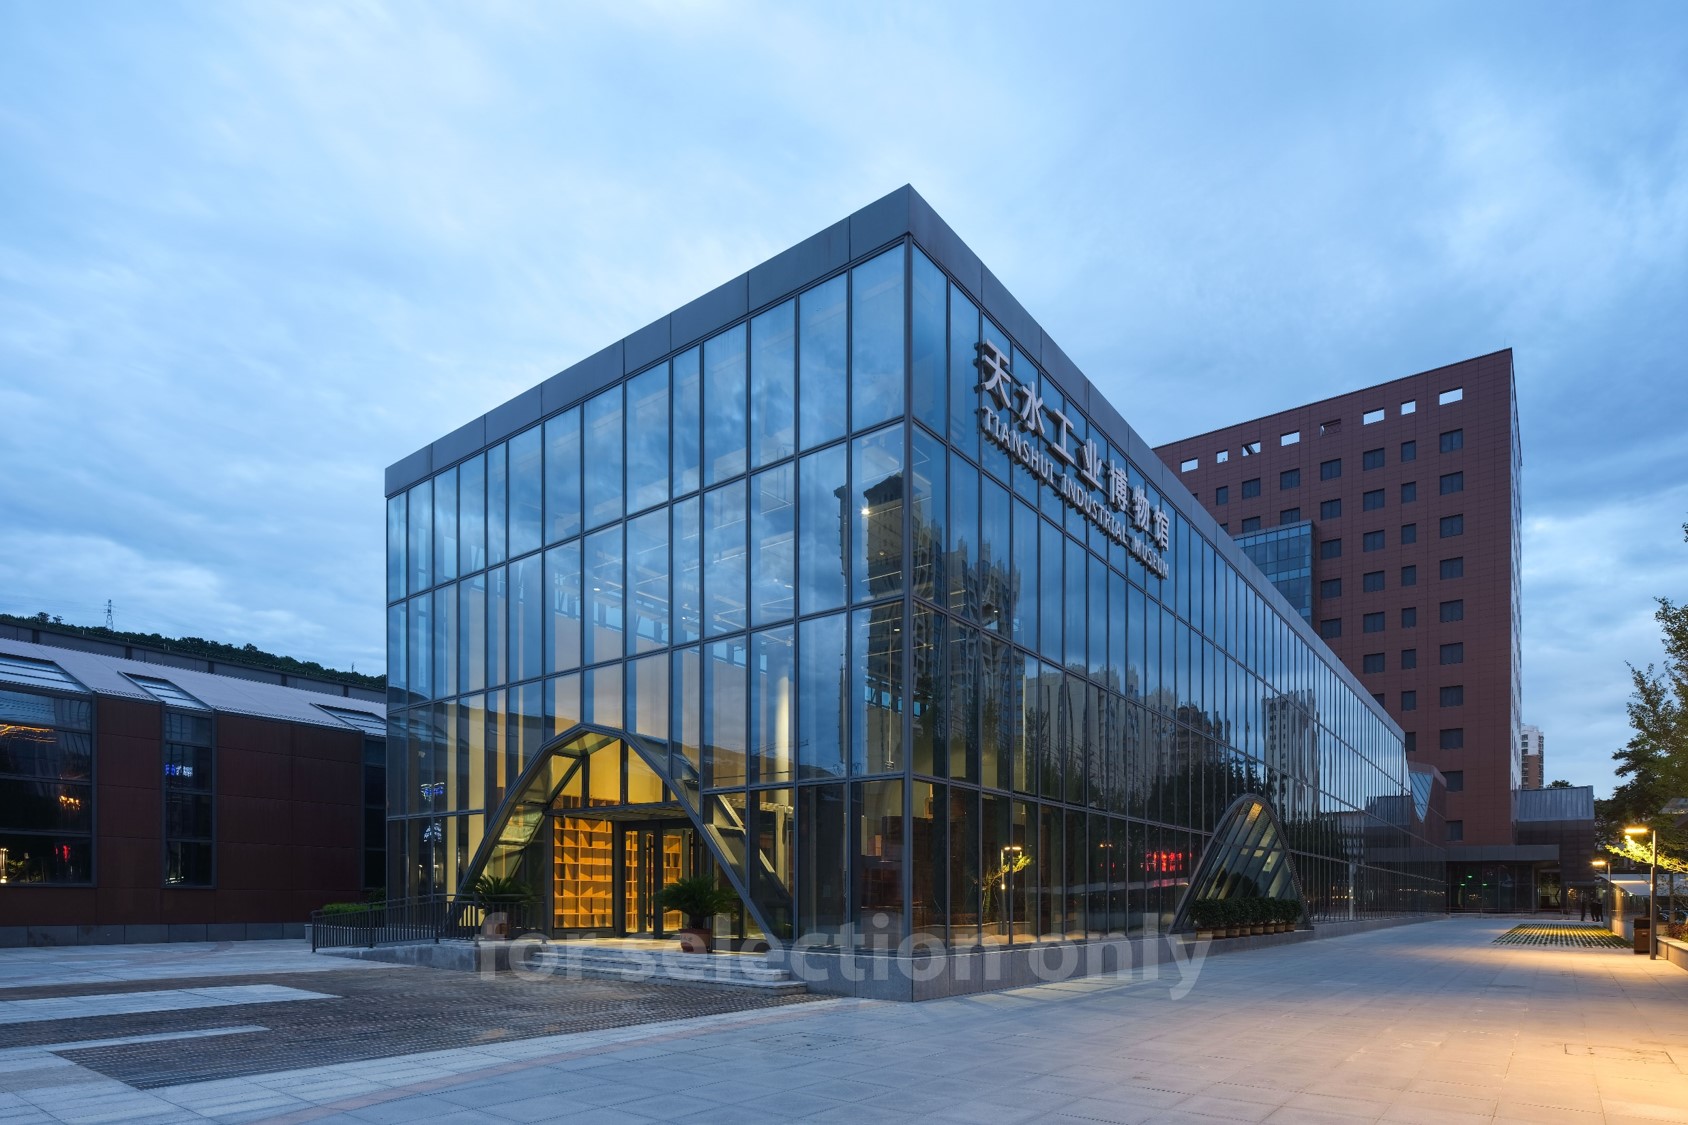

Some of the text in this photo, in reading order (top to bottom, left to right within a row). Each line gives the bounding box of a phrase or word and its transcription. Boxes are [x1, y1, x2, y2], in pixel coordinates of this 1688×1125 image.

[980, 338, 1170, 551] 天水工业博物馆
[981, 405, 1169, 580] TIANSHUI INDUSTRIAL MUSEUM
